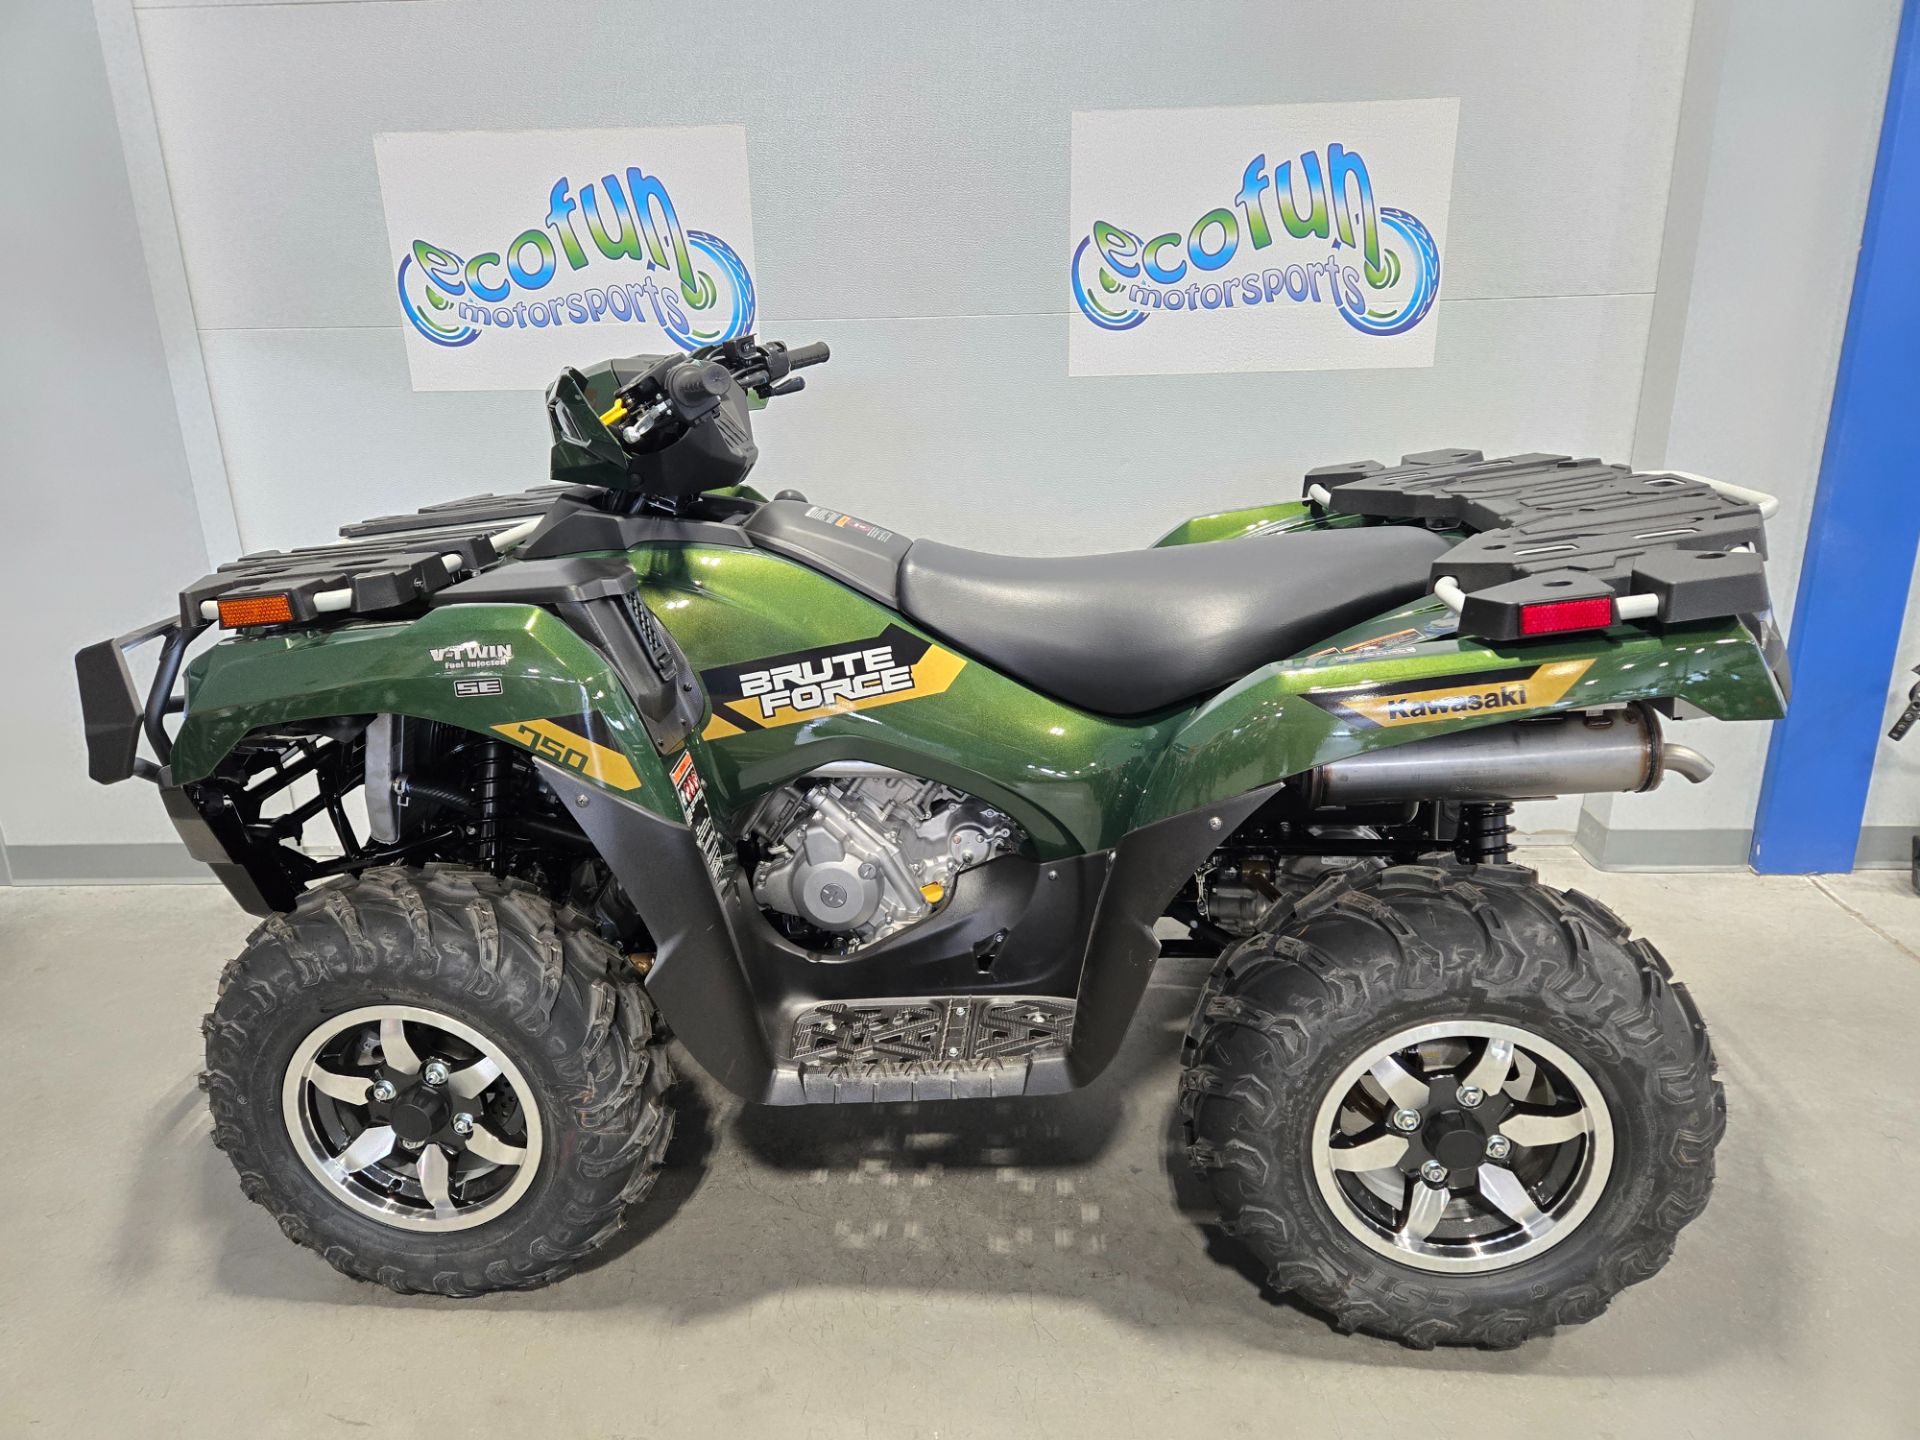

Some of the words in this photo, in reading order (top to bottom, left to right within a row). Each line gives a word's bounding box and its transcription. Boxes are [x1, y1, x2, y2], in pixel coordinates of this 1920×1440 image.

[412, 166, 697, 302] ecofun
[1094, 143, 1381, 284] ecofun
[458, 276, 690, 336] motorsports
[1129, 254, 1366, 315] motorsports
[429, 643, 512, 662] V-TWIN
[739, 646, 896, 697] BRUTE
[456, 680, 501, 695] SE
[760, 665, 915, 718] FORCE
[1389, 685, 1527, 720] Kawasaki
[518, 725, 588, 773] 750
